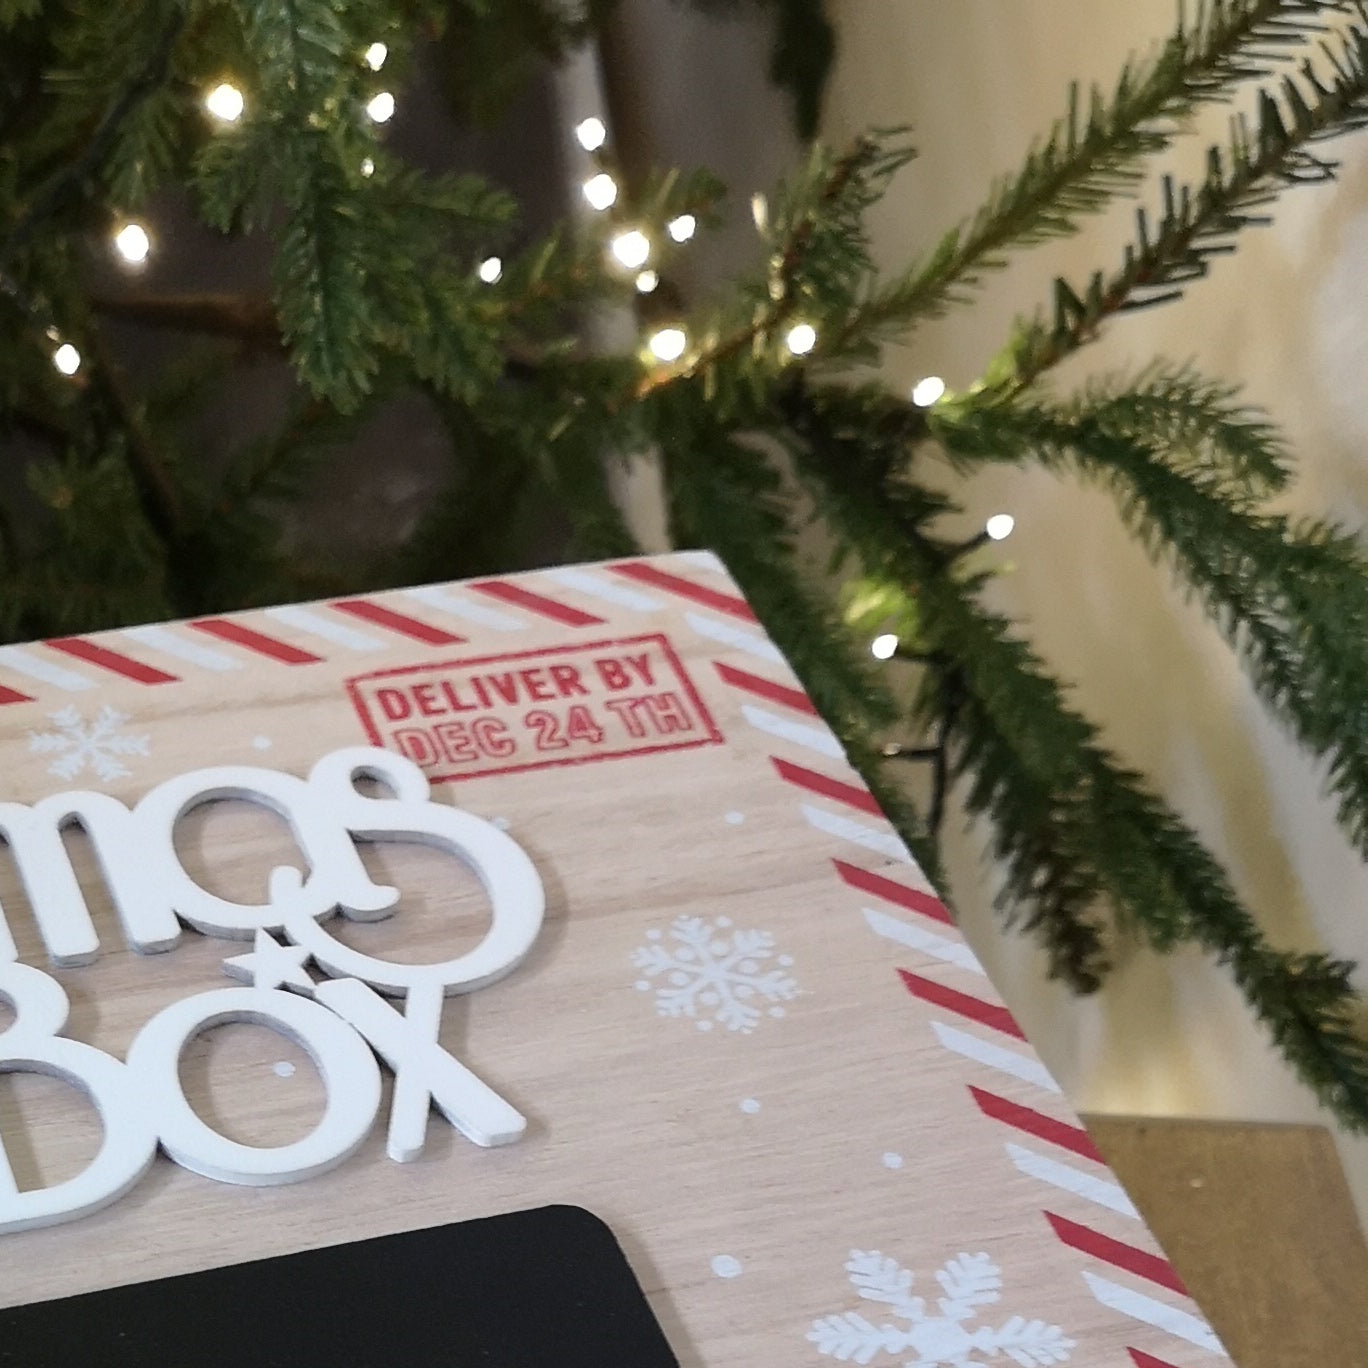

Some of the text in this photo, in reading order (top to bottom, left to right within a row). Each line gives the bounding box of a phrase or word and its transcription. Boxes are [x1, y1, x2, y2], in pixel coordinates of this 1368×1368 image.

[375, 652, 655, 722] DELIVER BY
[392, 692, 696, 768] DEC 24 TH
